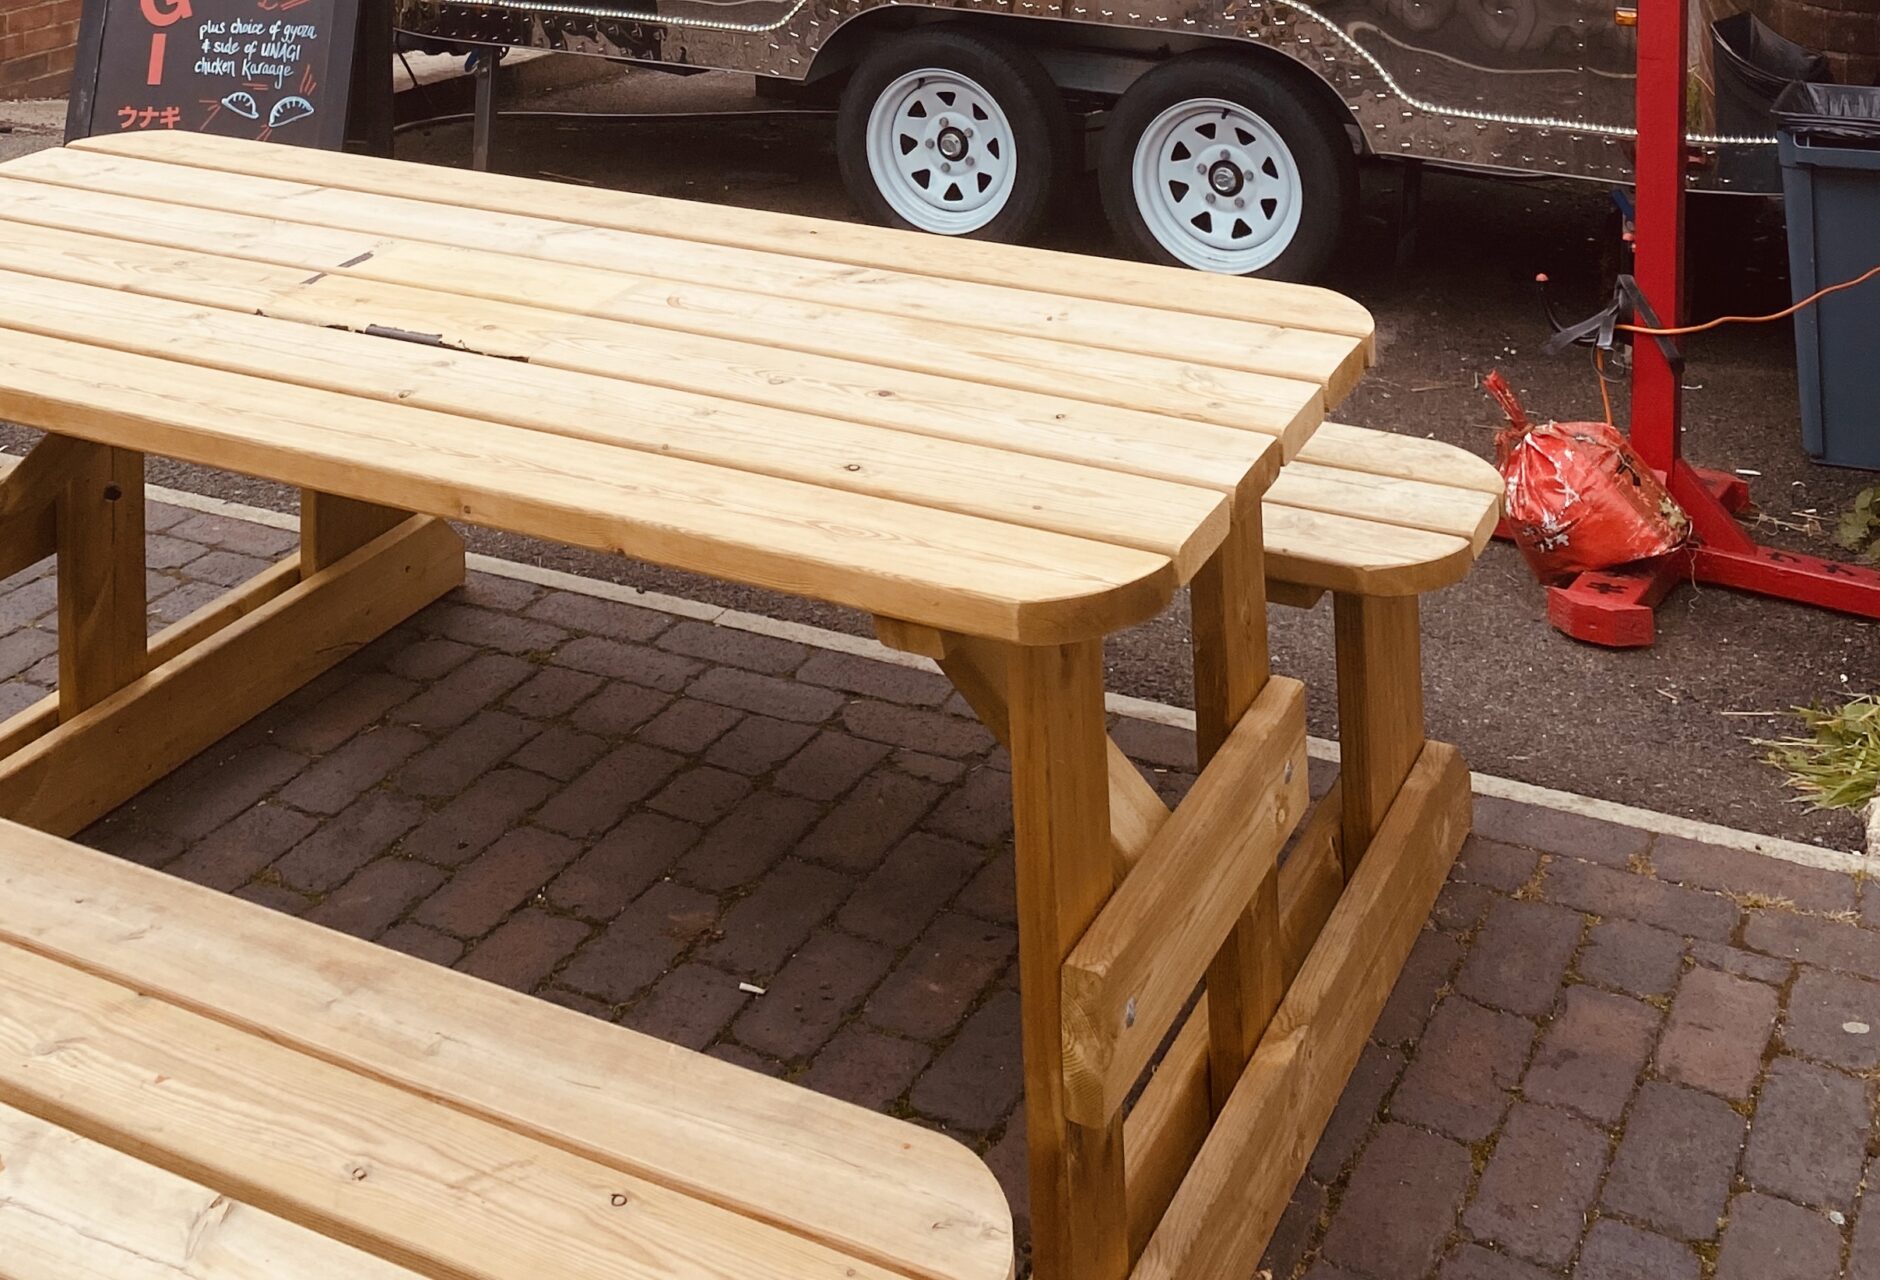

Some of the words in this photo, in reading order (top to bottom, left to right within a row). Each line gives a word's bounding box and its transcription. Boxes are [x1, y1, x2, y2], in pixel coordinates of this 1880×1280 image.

[199, 19, 226, 40] plus
[230, 17, 265, 35] choice
[268, 20, 282, 40] of
[281, 23, 318, 43] gyoza
[213, 37, 240, 55] side
[244, 40, 258, 60] of
[261, 42, 301, 63] UNAGI
[194, 57, 236, 77] chicken
[117, 105, 181, 130] ウナギ
